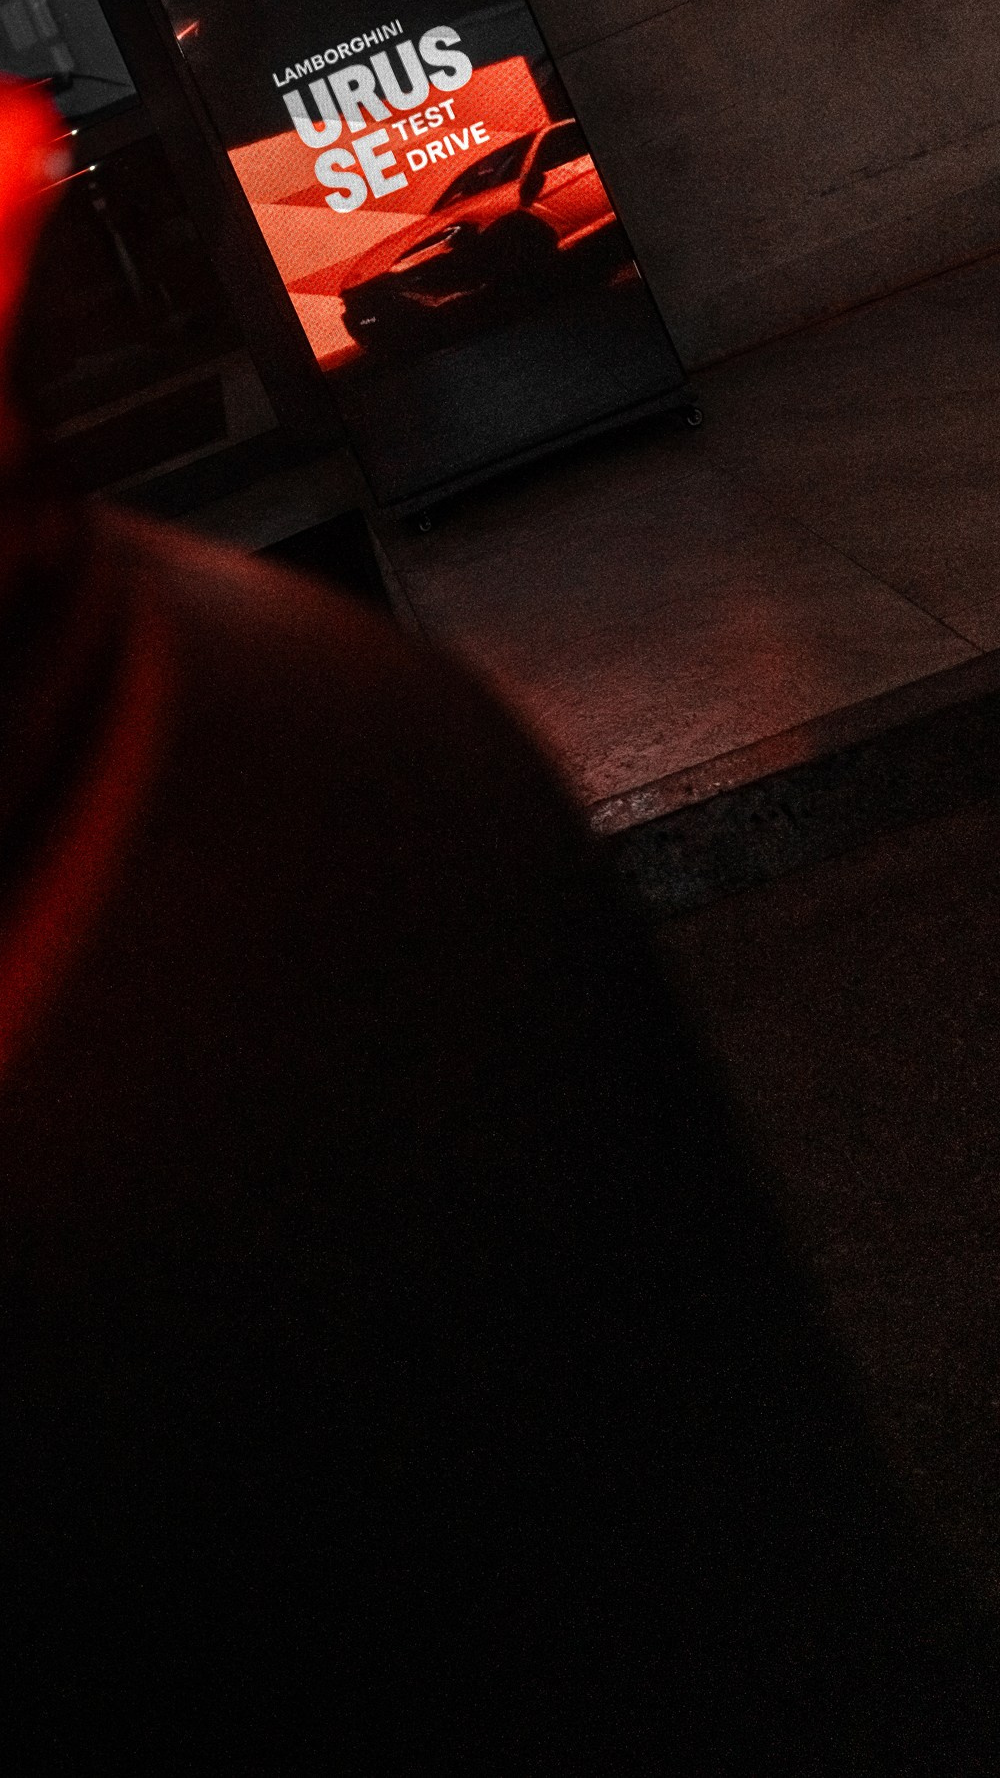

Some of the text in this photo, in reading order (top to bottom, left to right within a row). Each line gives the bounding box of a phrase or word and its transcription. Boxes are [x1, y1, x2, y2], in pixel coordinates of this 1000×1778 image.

[272, 19, 404, 88] LAMBORGHINI
[282, 25, 473, 149] URUS
[392, 98, 457, 141] TEST
[406, 121, 491, 171] DRIVE
[314, 128, 409, 213] SE
